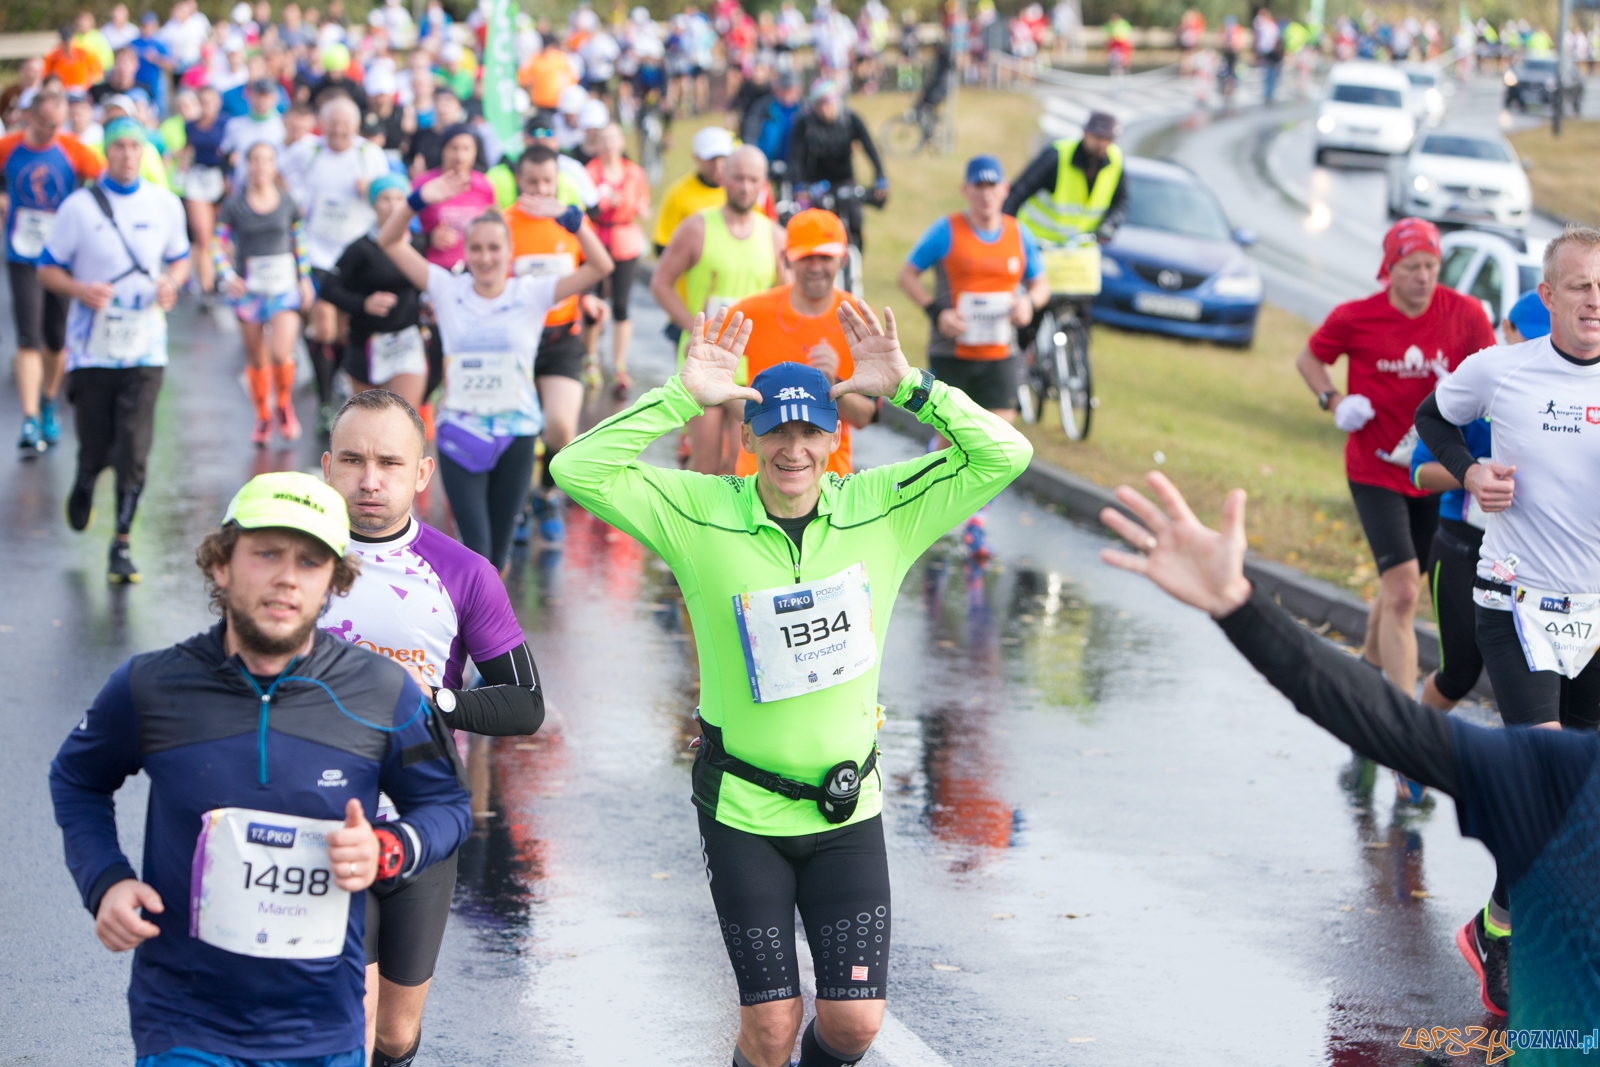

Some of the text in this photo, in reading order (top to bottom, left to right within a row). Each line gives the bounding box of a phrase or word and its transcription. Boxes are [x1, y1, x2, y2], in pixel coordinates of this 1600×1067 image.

[1542, 422, 1581, 434] Bartek
[779, 610, 851, 649] 1334
[1545, 621, 1593, 640] 4417
[794, 639, 848, 663] Krzysztof
[242, 861, 331, 896] 1498
[257, 901, 308, 917] Marcin
[744, 985, 793, 1003] COMPRE
[822, 987, 878, 998] SSPORT
